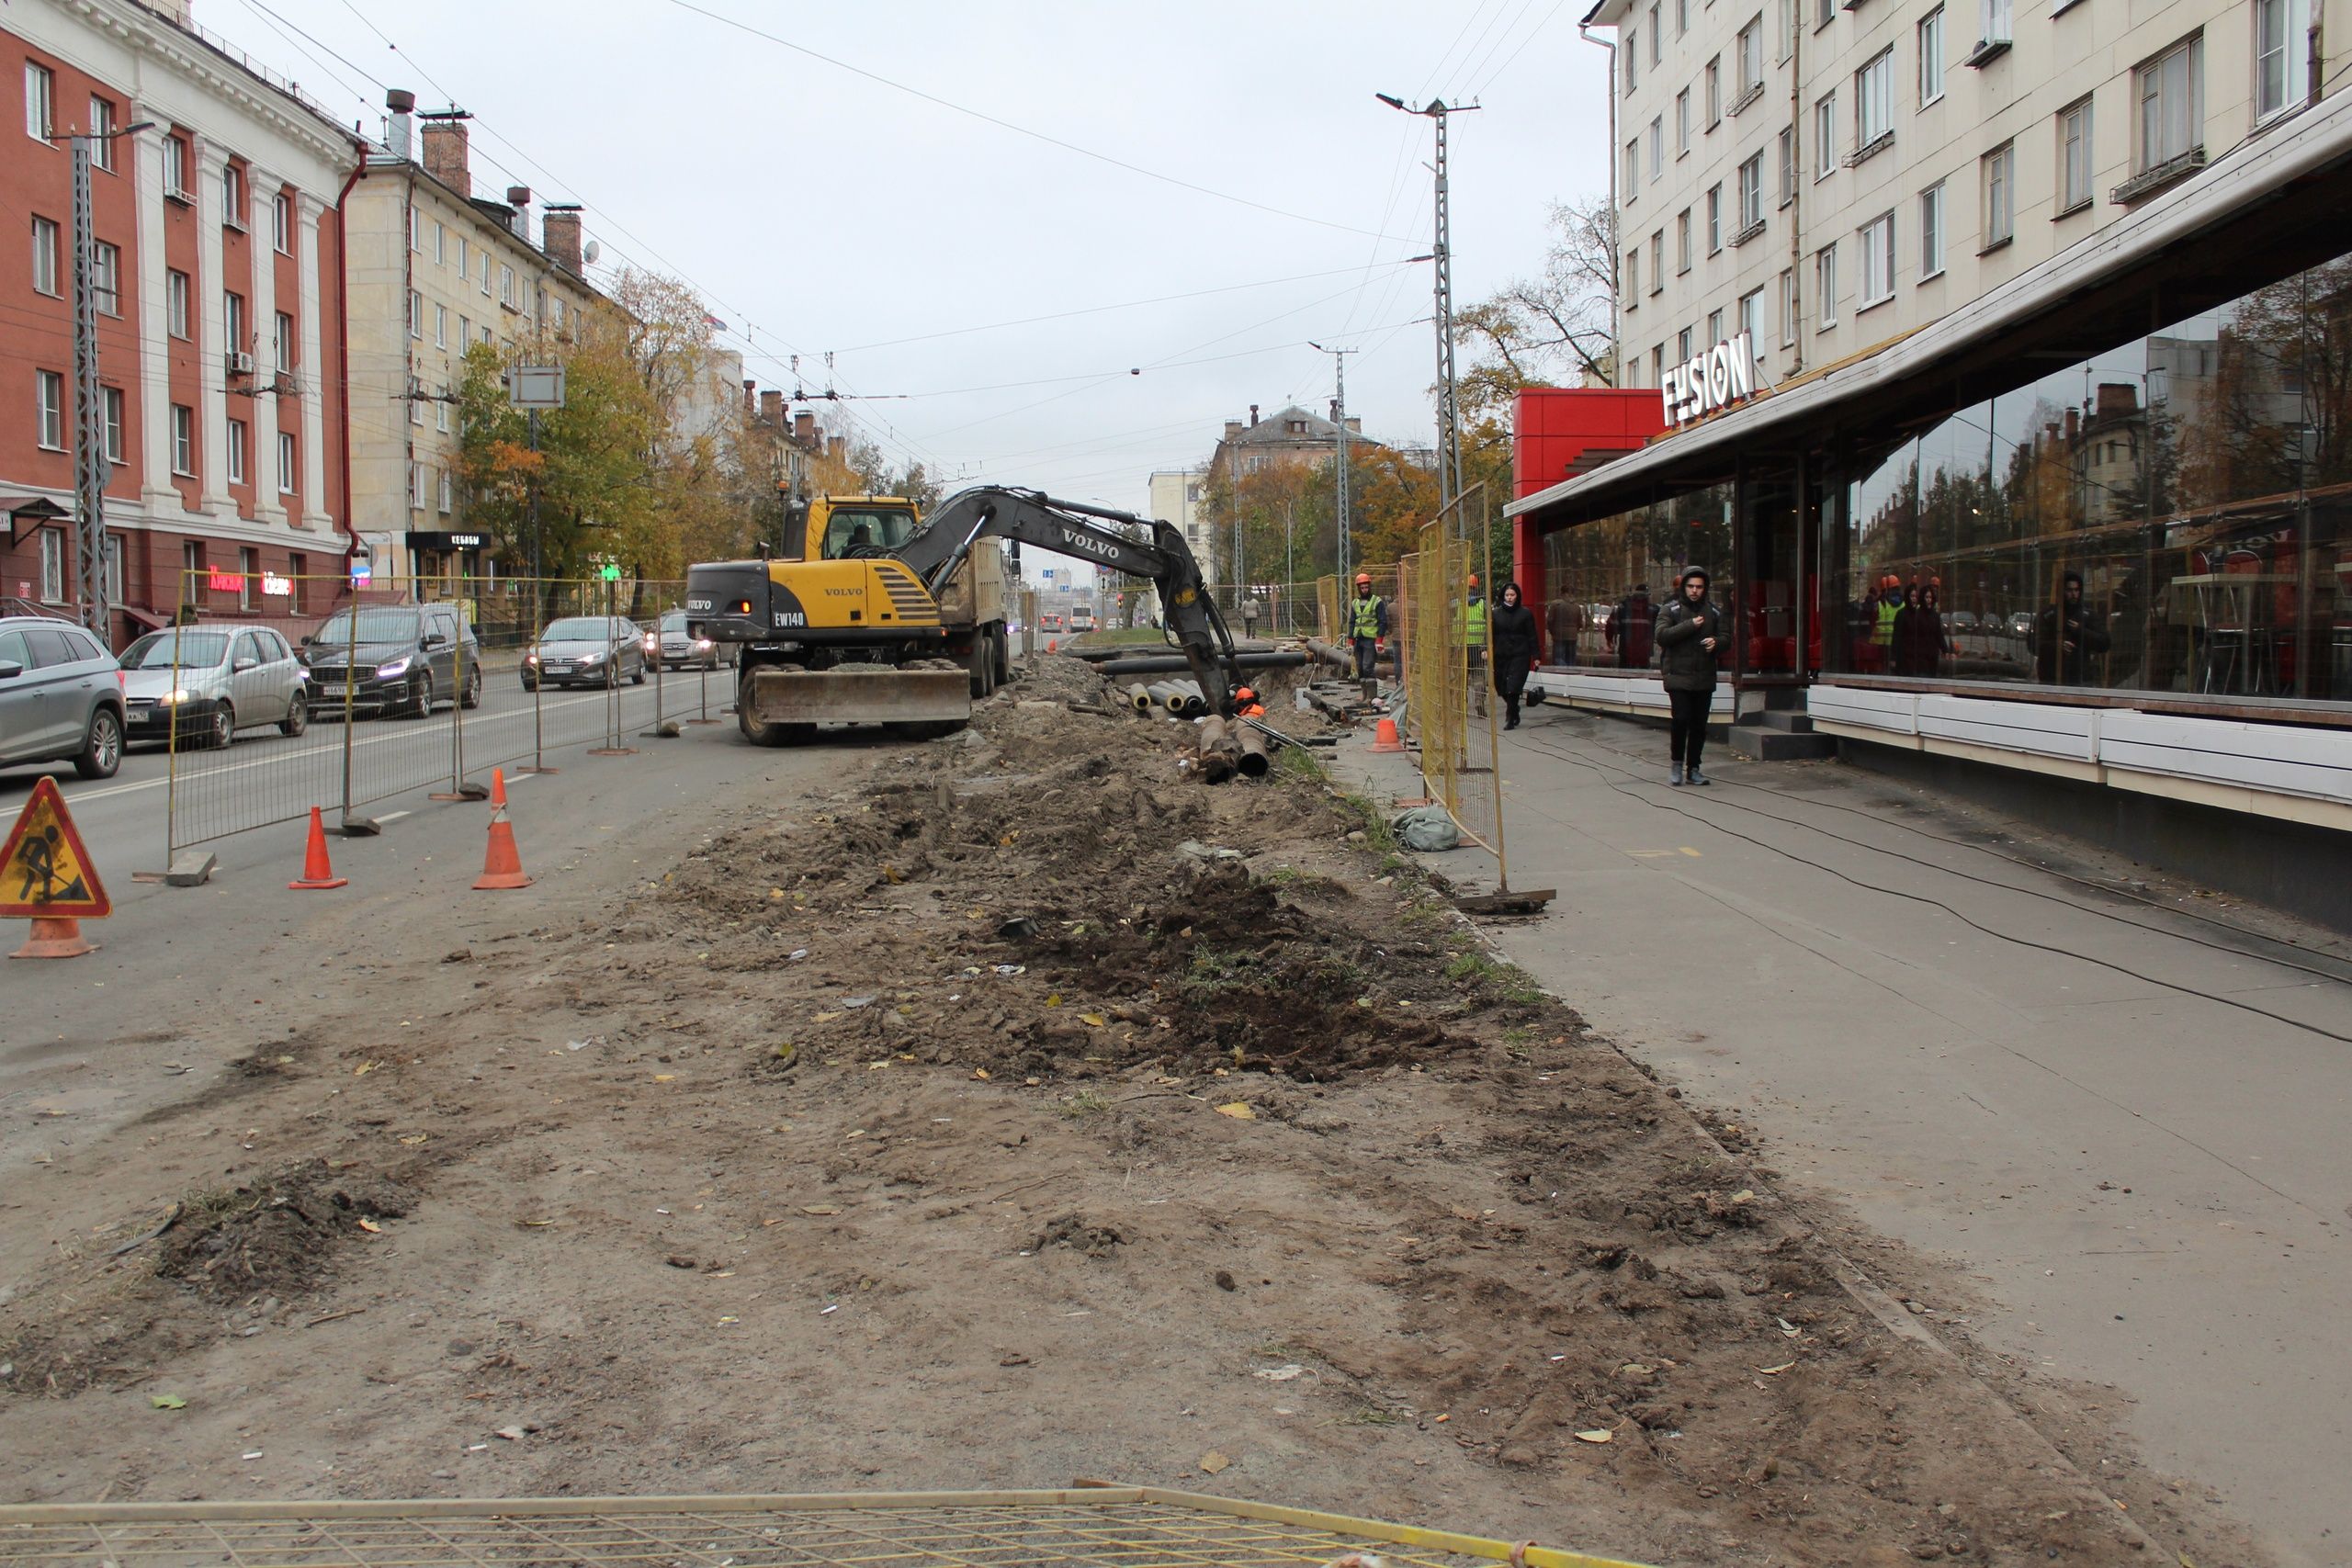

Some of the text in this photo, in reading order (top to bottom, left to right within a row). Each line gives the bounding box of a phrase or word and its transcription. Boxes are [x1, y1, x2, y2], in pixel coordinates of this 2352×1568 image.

[1662, 333, 1753, 426] FUSION
[451, 535, 480, 546] КЕБАБЫ
[1063, 529, 1119, 558] VOLVO
[824, 588, 863, 596] VOLVO
[687, 600, 712, 610] VOLVO
[775, 612, 804, 627] EW140
